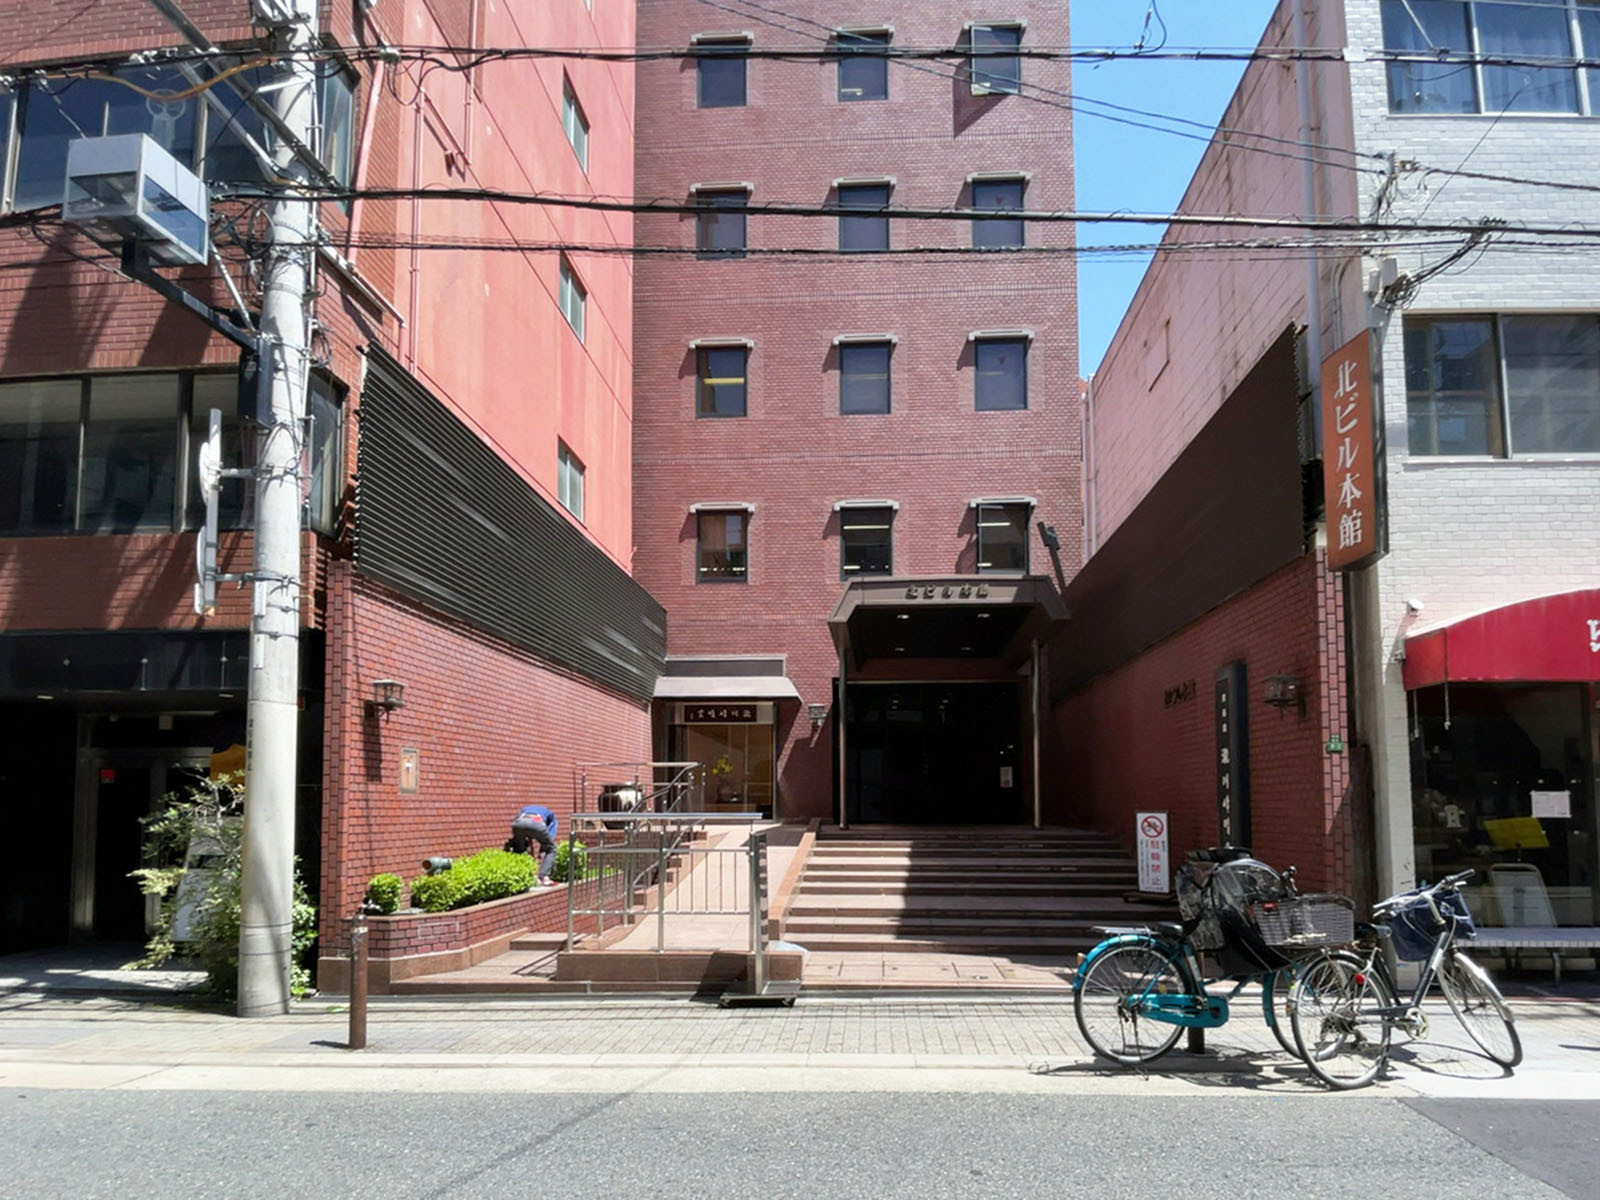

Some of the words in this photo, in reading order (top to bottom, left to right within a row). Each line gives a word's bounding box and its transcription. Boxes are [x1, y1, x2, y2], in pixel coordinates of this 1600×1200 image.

[1334, 360, 1362, 549] 北ビル本館
